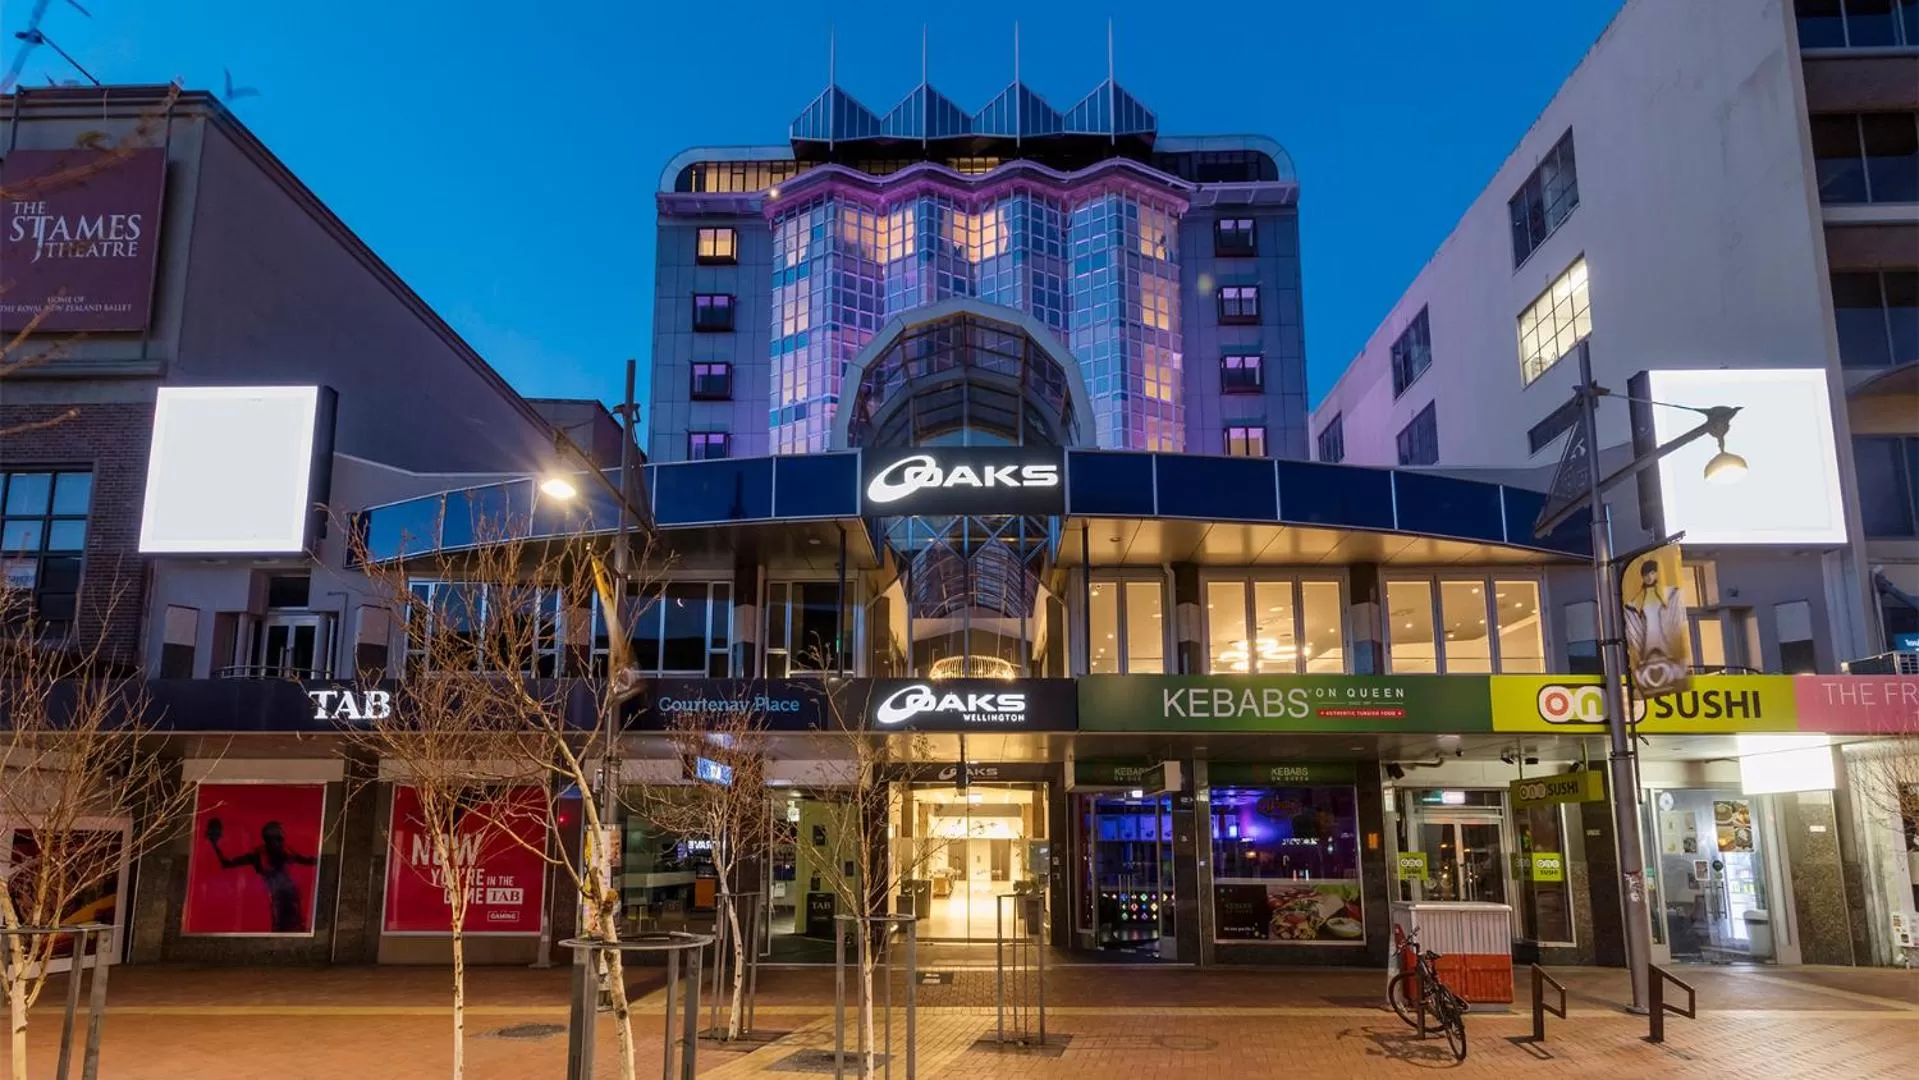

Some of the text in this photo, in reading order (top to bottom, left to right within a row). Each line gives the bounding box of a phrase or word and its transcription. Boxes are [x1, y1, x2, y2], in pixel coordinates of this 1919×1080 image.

[12, 201, 47, 214] THE
[45, 242, 138, 258] THEATRE
[867, 455, 1059, 503] OAKS
[1822, 682, 1876, 705] THE
[308, 690, 391, 719] TAB
[658, 696, 801, 714] Courtenay Place
[877, 684, 1026, 724] OAKS
[1163, 687, 1404, 718] KEBABS ON QUEEN
[1655, 690, 1761, 719] SUSHI
[963, 714, 1025, 722] WELLINGTON
[1271, 767, 1309, 777] KEBABS
[1547, 783, 1579, 796] SUSHI
[487, 876, 496, 886] IN
[499, 876, 515, 886] THE
[489, 890, 521, 902] TAB
[812, 902, 831, 910] TAB
